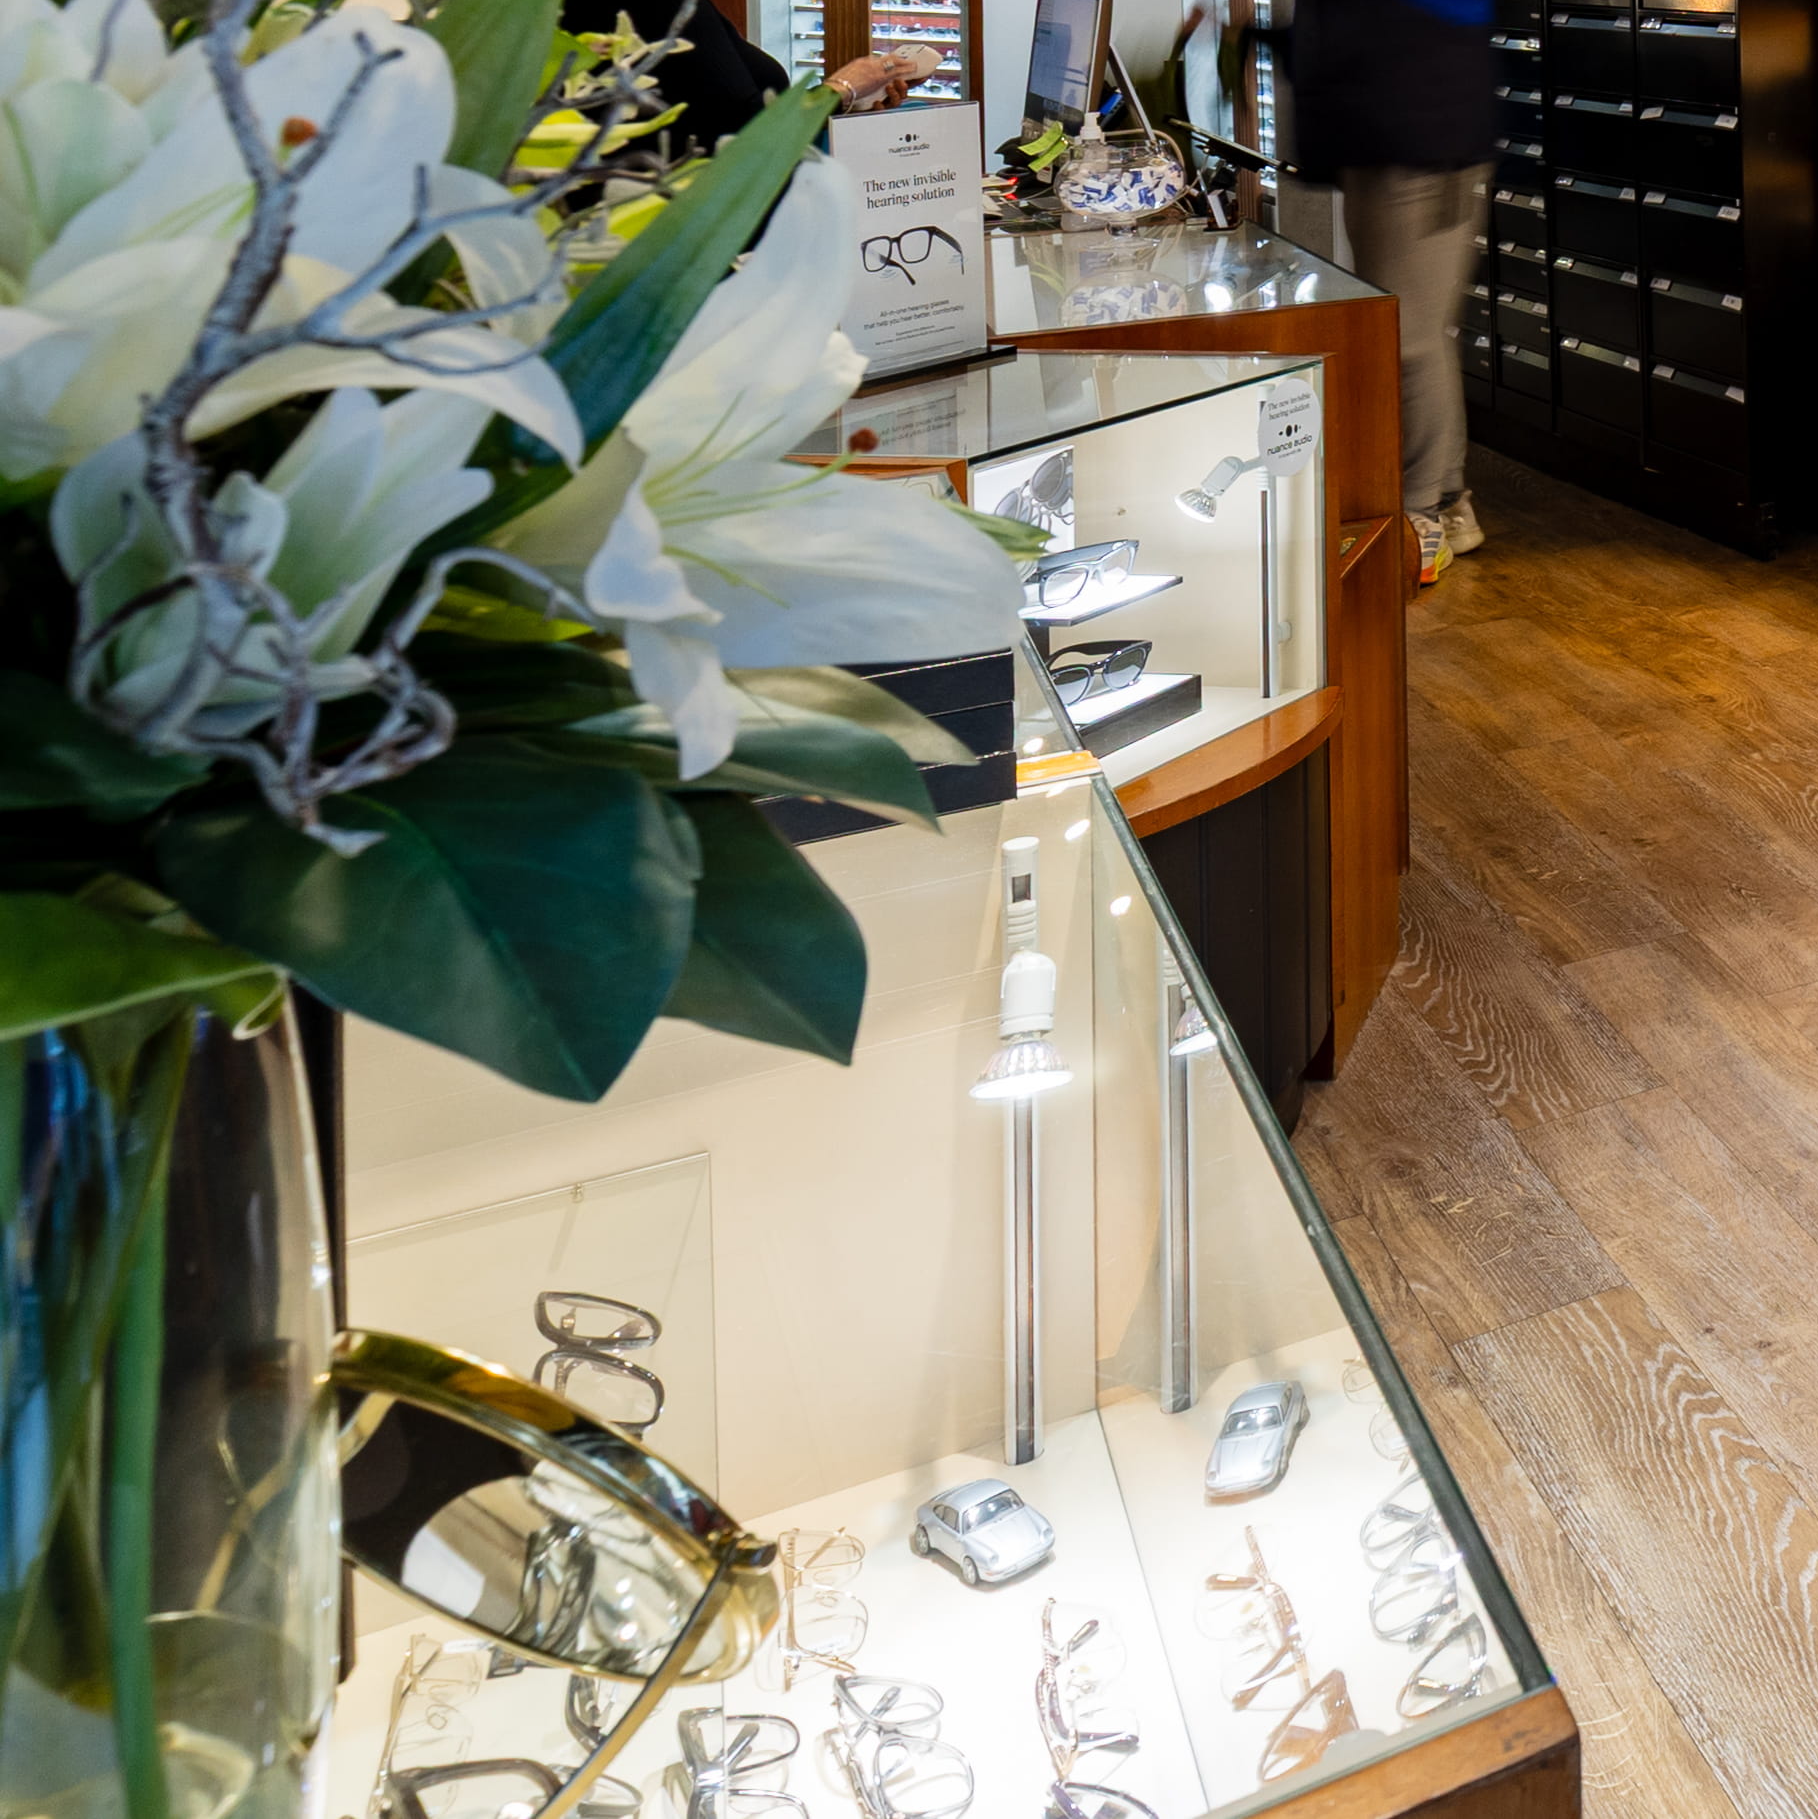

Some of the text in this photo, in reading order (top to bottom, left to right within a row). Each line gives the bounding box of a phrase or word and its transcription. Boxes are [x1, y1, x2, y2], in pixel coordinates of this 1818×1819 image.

[863, 168, 957, 193] The new invisible
[867, 187, 955, 210] hearing solution
[1267, 441, 1293, 456] nuance
[1294, 434, 1313, 447] audio
